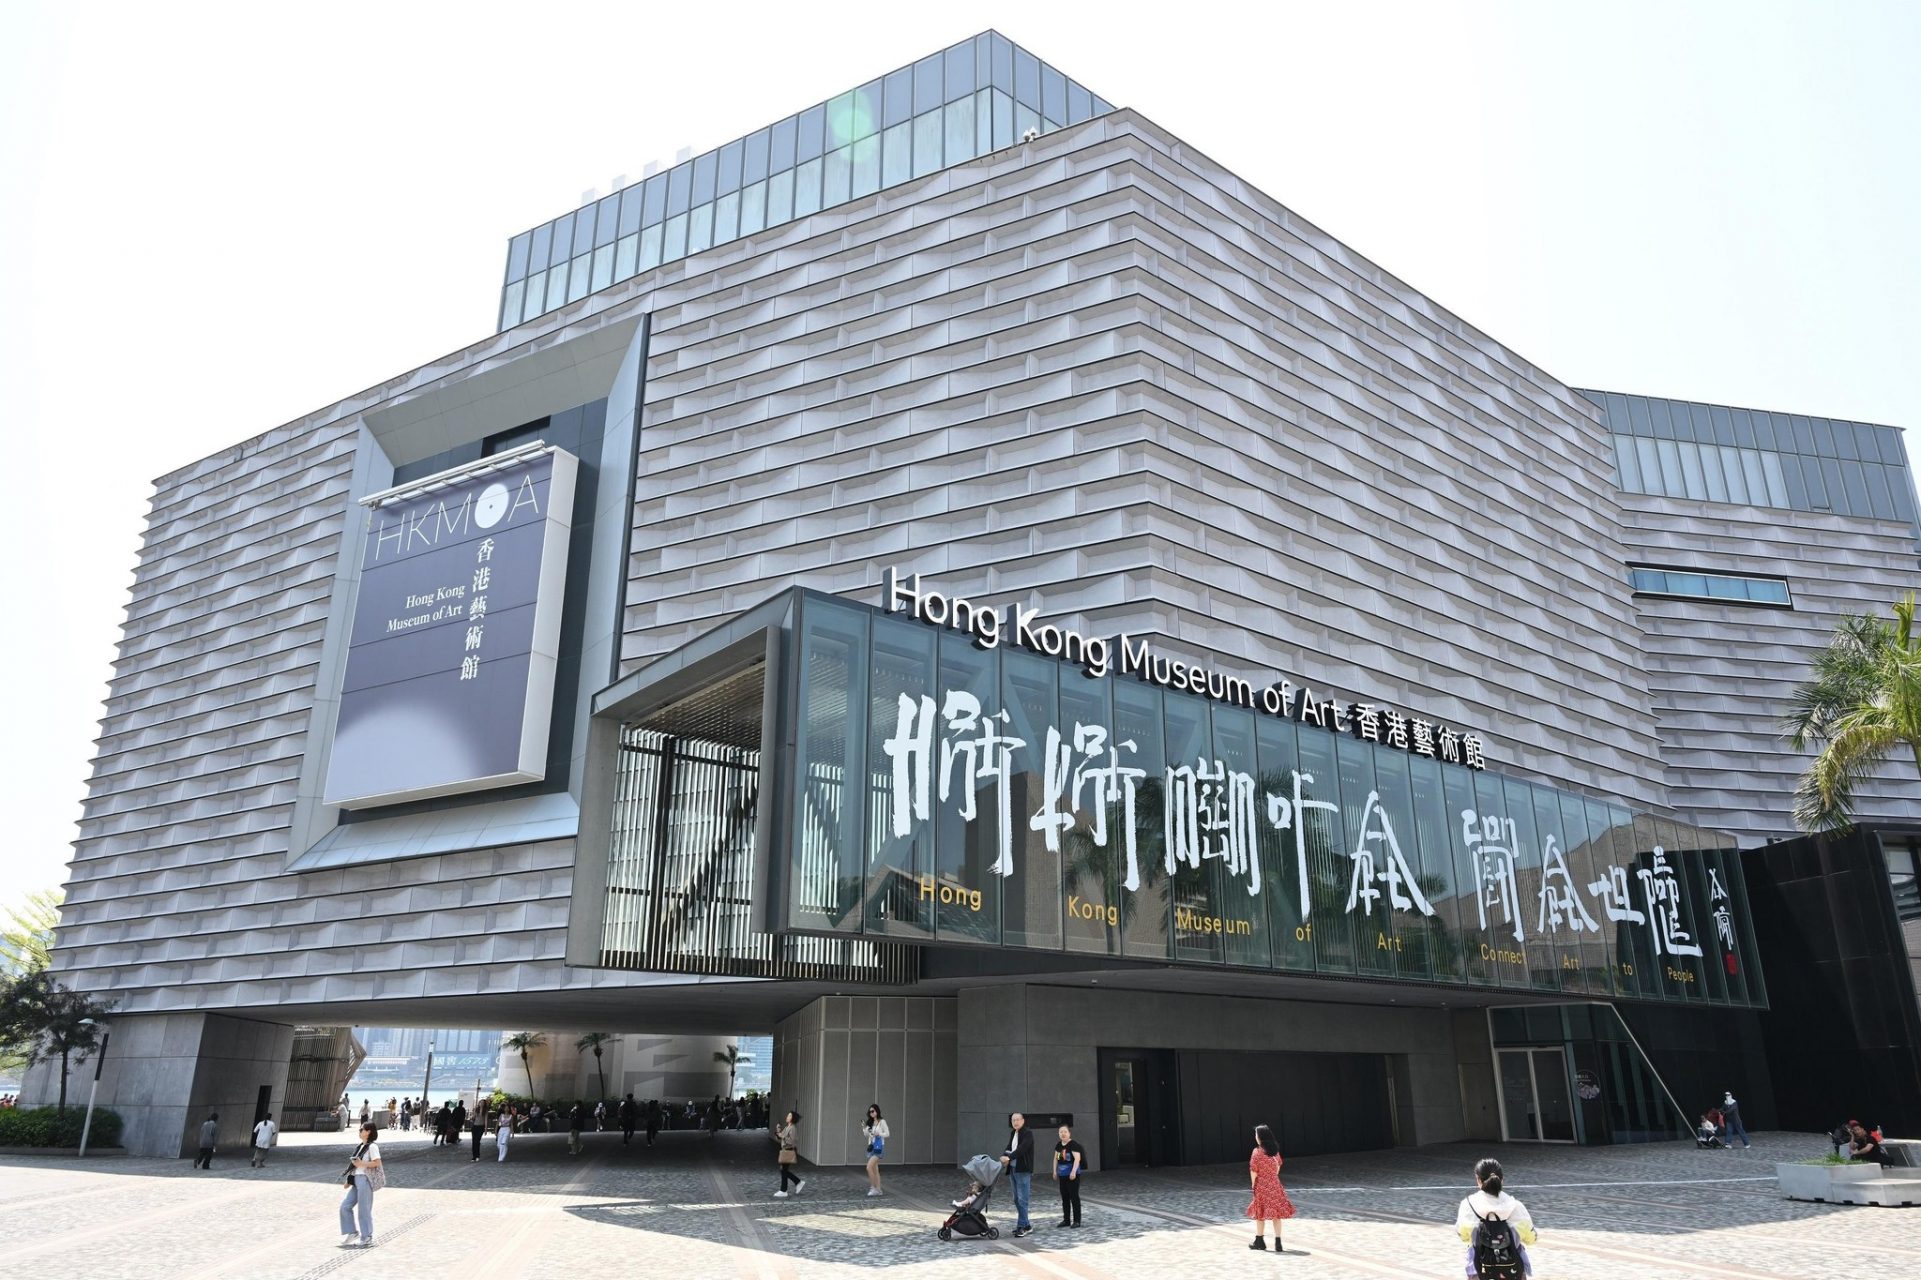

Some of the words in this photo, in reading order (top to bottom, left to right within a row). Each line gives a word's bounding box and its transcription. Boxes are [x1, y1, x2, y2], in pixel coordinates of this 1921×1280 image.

[386, 613, 431, 632] Museum
[432, 605, 446, 621] of
[445, 604, 463, 618] Art
[405, 594, 435, 609] Hong
[436, 585, 466, 601] Kong
[459, 537, 495, 681] 香港藝術館
[891, 565, 1000, 649] Hong
[1015, 602, 1107, 677] Kong
[1120, 633, 1255, 708] Museum
[1263, 680, 1292, 717] of
[1301, 687, 1345, 731] Art
[1355, 702, 1486, 771] 香港藝術館
[920, 877, 982, 912] Hong
[1068, 895, 1118, 927] Kong
[1177, 908, 1250, 936] Museum
[1295, 923, 1312, 942] of
[1377, 932, 1402, 952] Art
[1480, 943, 1527, 965] Connect
[1563, 954, 1580, 971] Art
[1623, 962, 1633, 976] to
[1667, 966, 1695, 984] People
